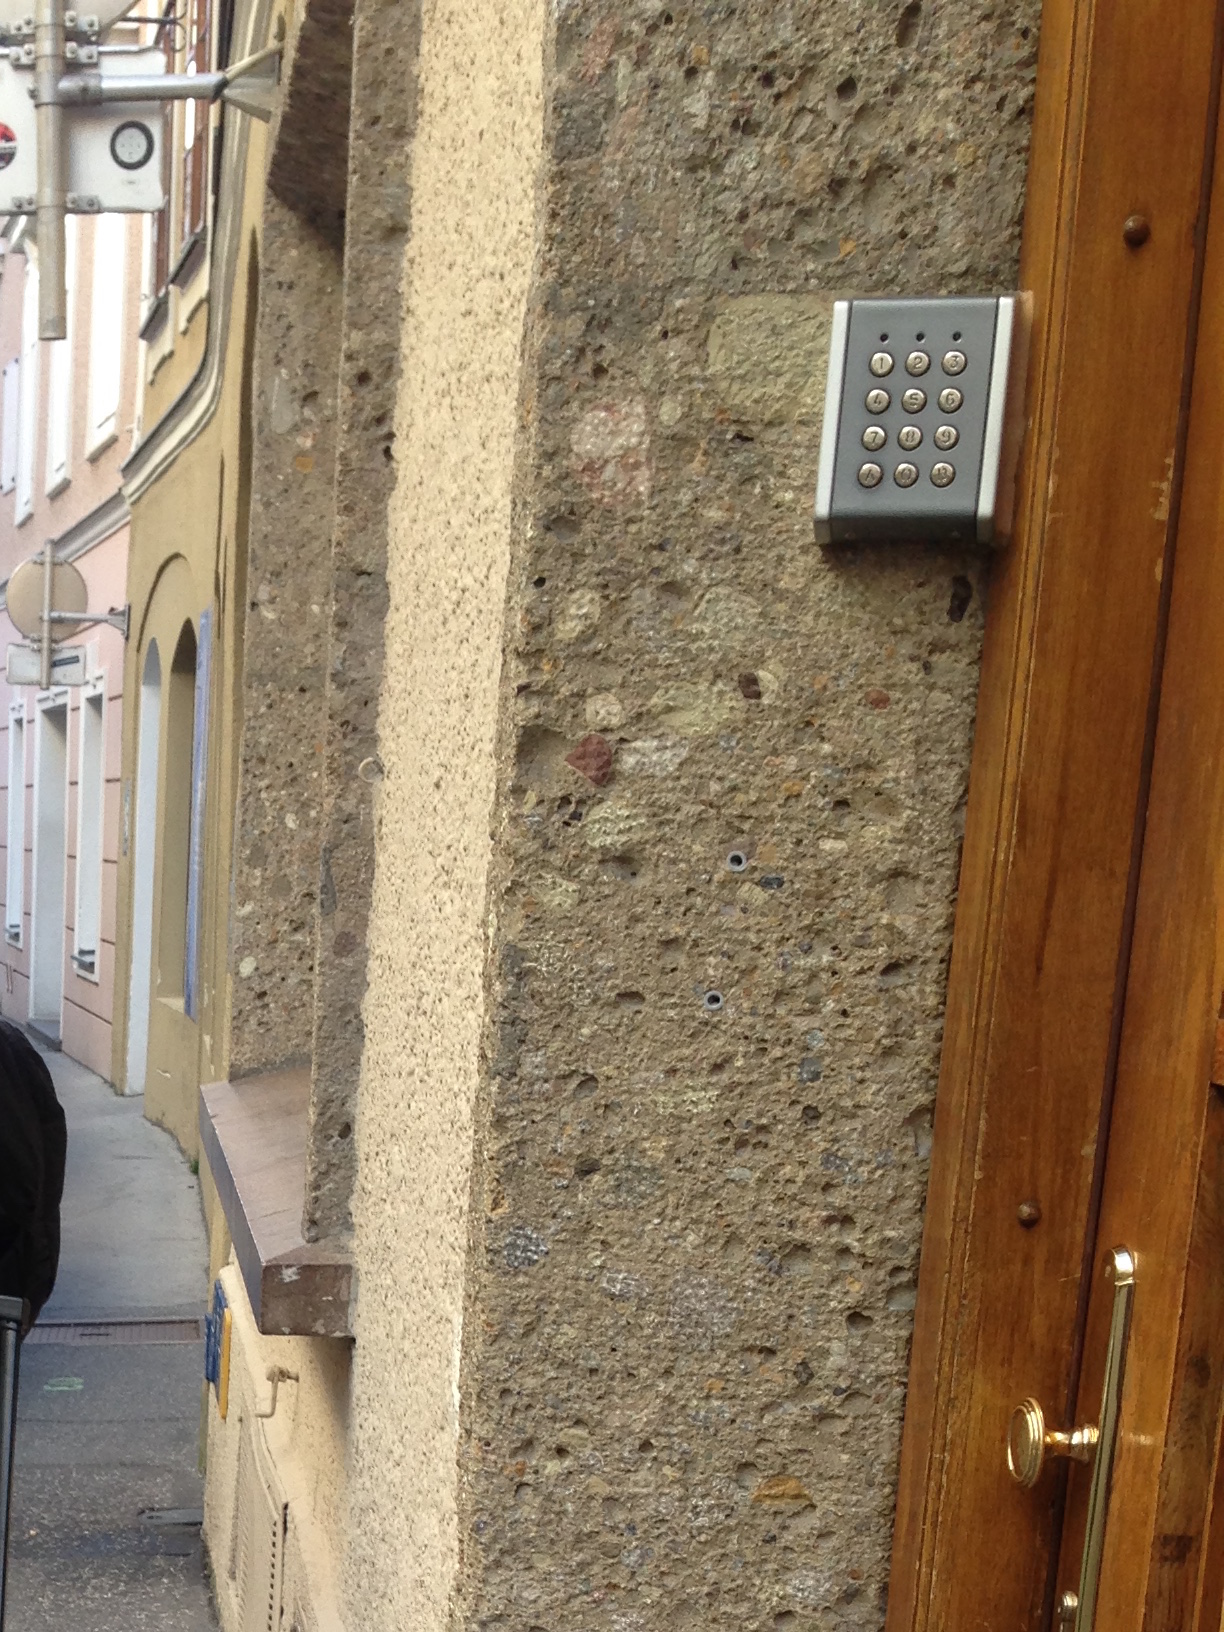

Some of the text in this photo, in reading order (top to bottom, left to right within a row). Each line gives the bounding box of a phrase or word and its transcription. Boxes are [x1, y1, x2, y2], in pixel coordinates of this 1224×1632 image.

[913, 356, 923, 370] 2
[950, 355, 959, 370] 3
[873, 392, 955, 408] 4 5 6
[870, 429, 951, 444] 7 8 9
